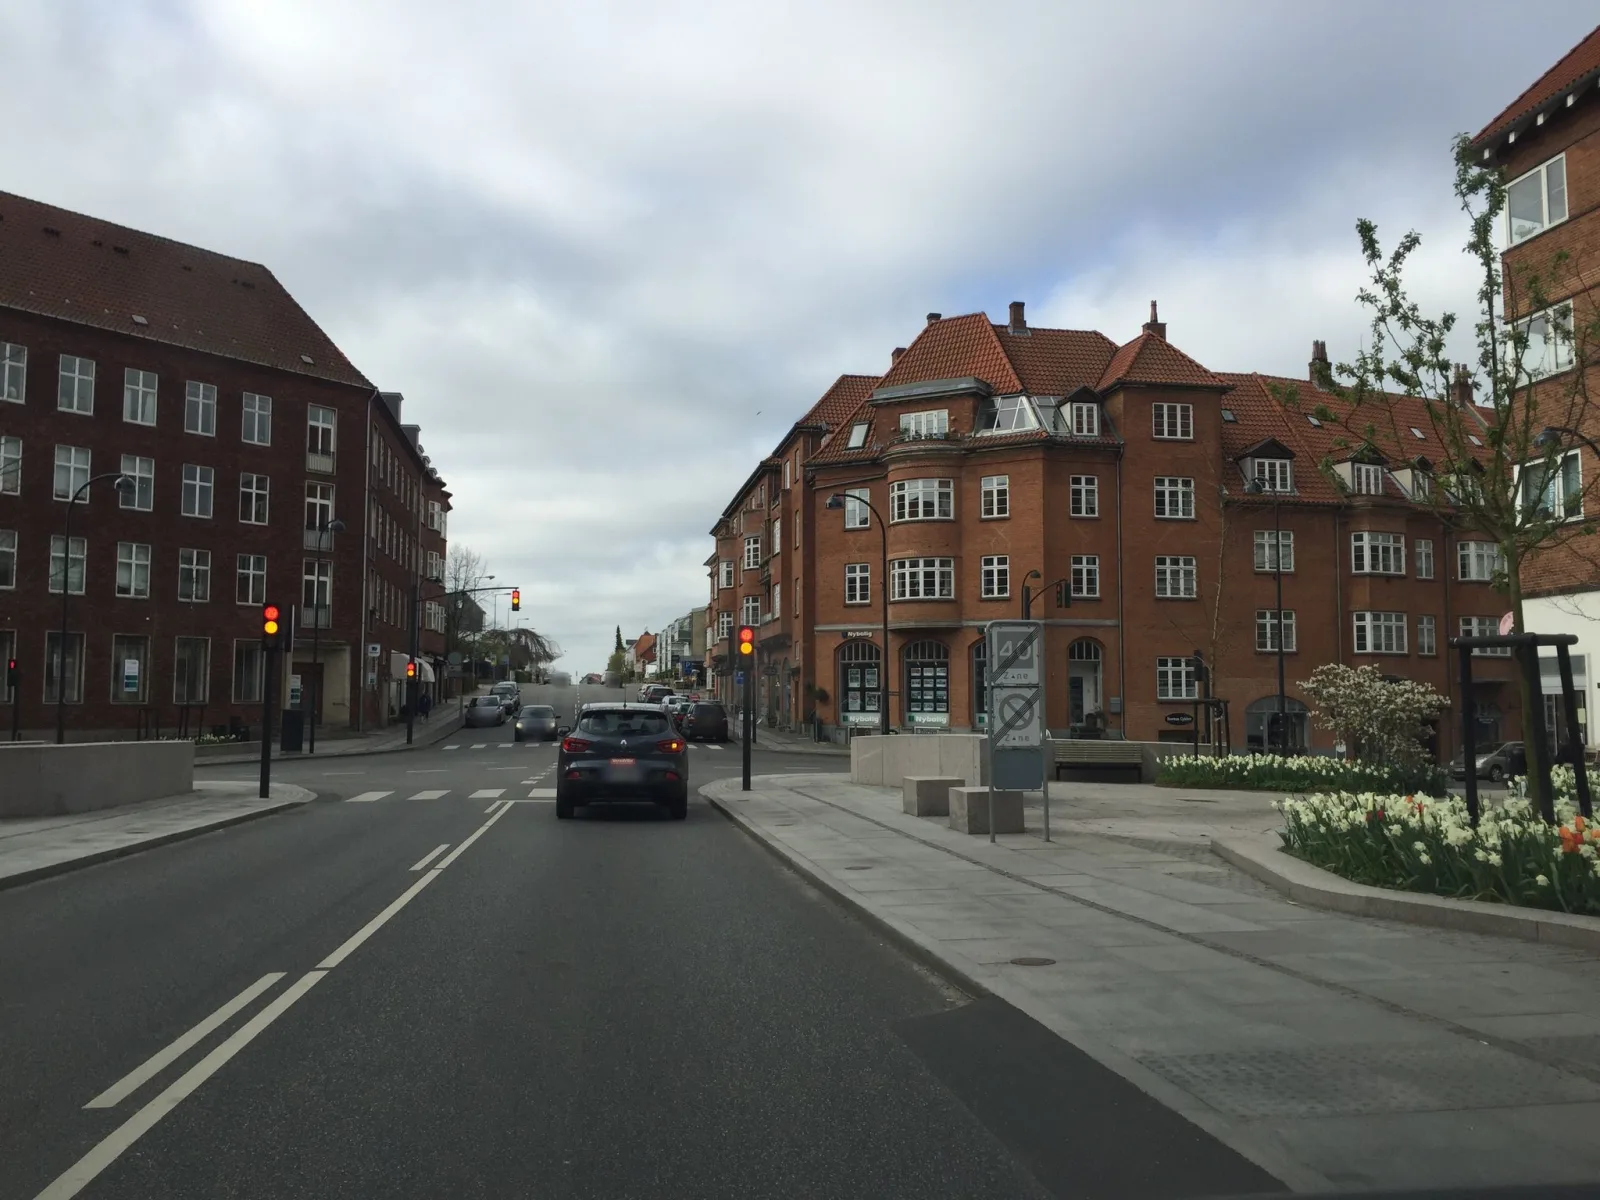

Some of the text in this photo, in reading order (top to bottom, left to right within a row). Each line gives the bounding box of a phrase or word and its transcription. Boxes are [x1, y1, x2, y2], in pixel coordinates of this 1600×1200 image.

[999, 640, 1032, 660] 40
[1003, 672, 1029, 680] Zne
[849, 716, 879, 724] Nybolig
[915, 716, 948, 724] Nybolig
[1004, 734, 1030, 742] Zne
